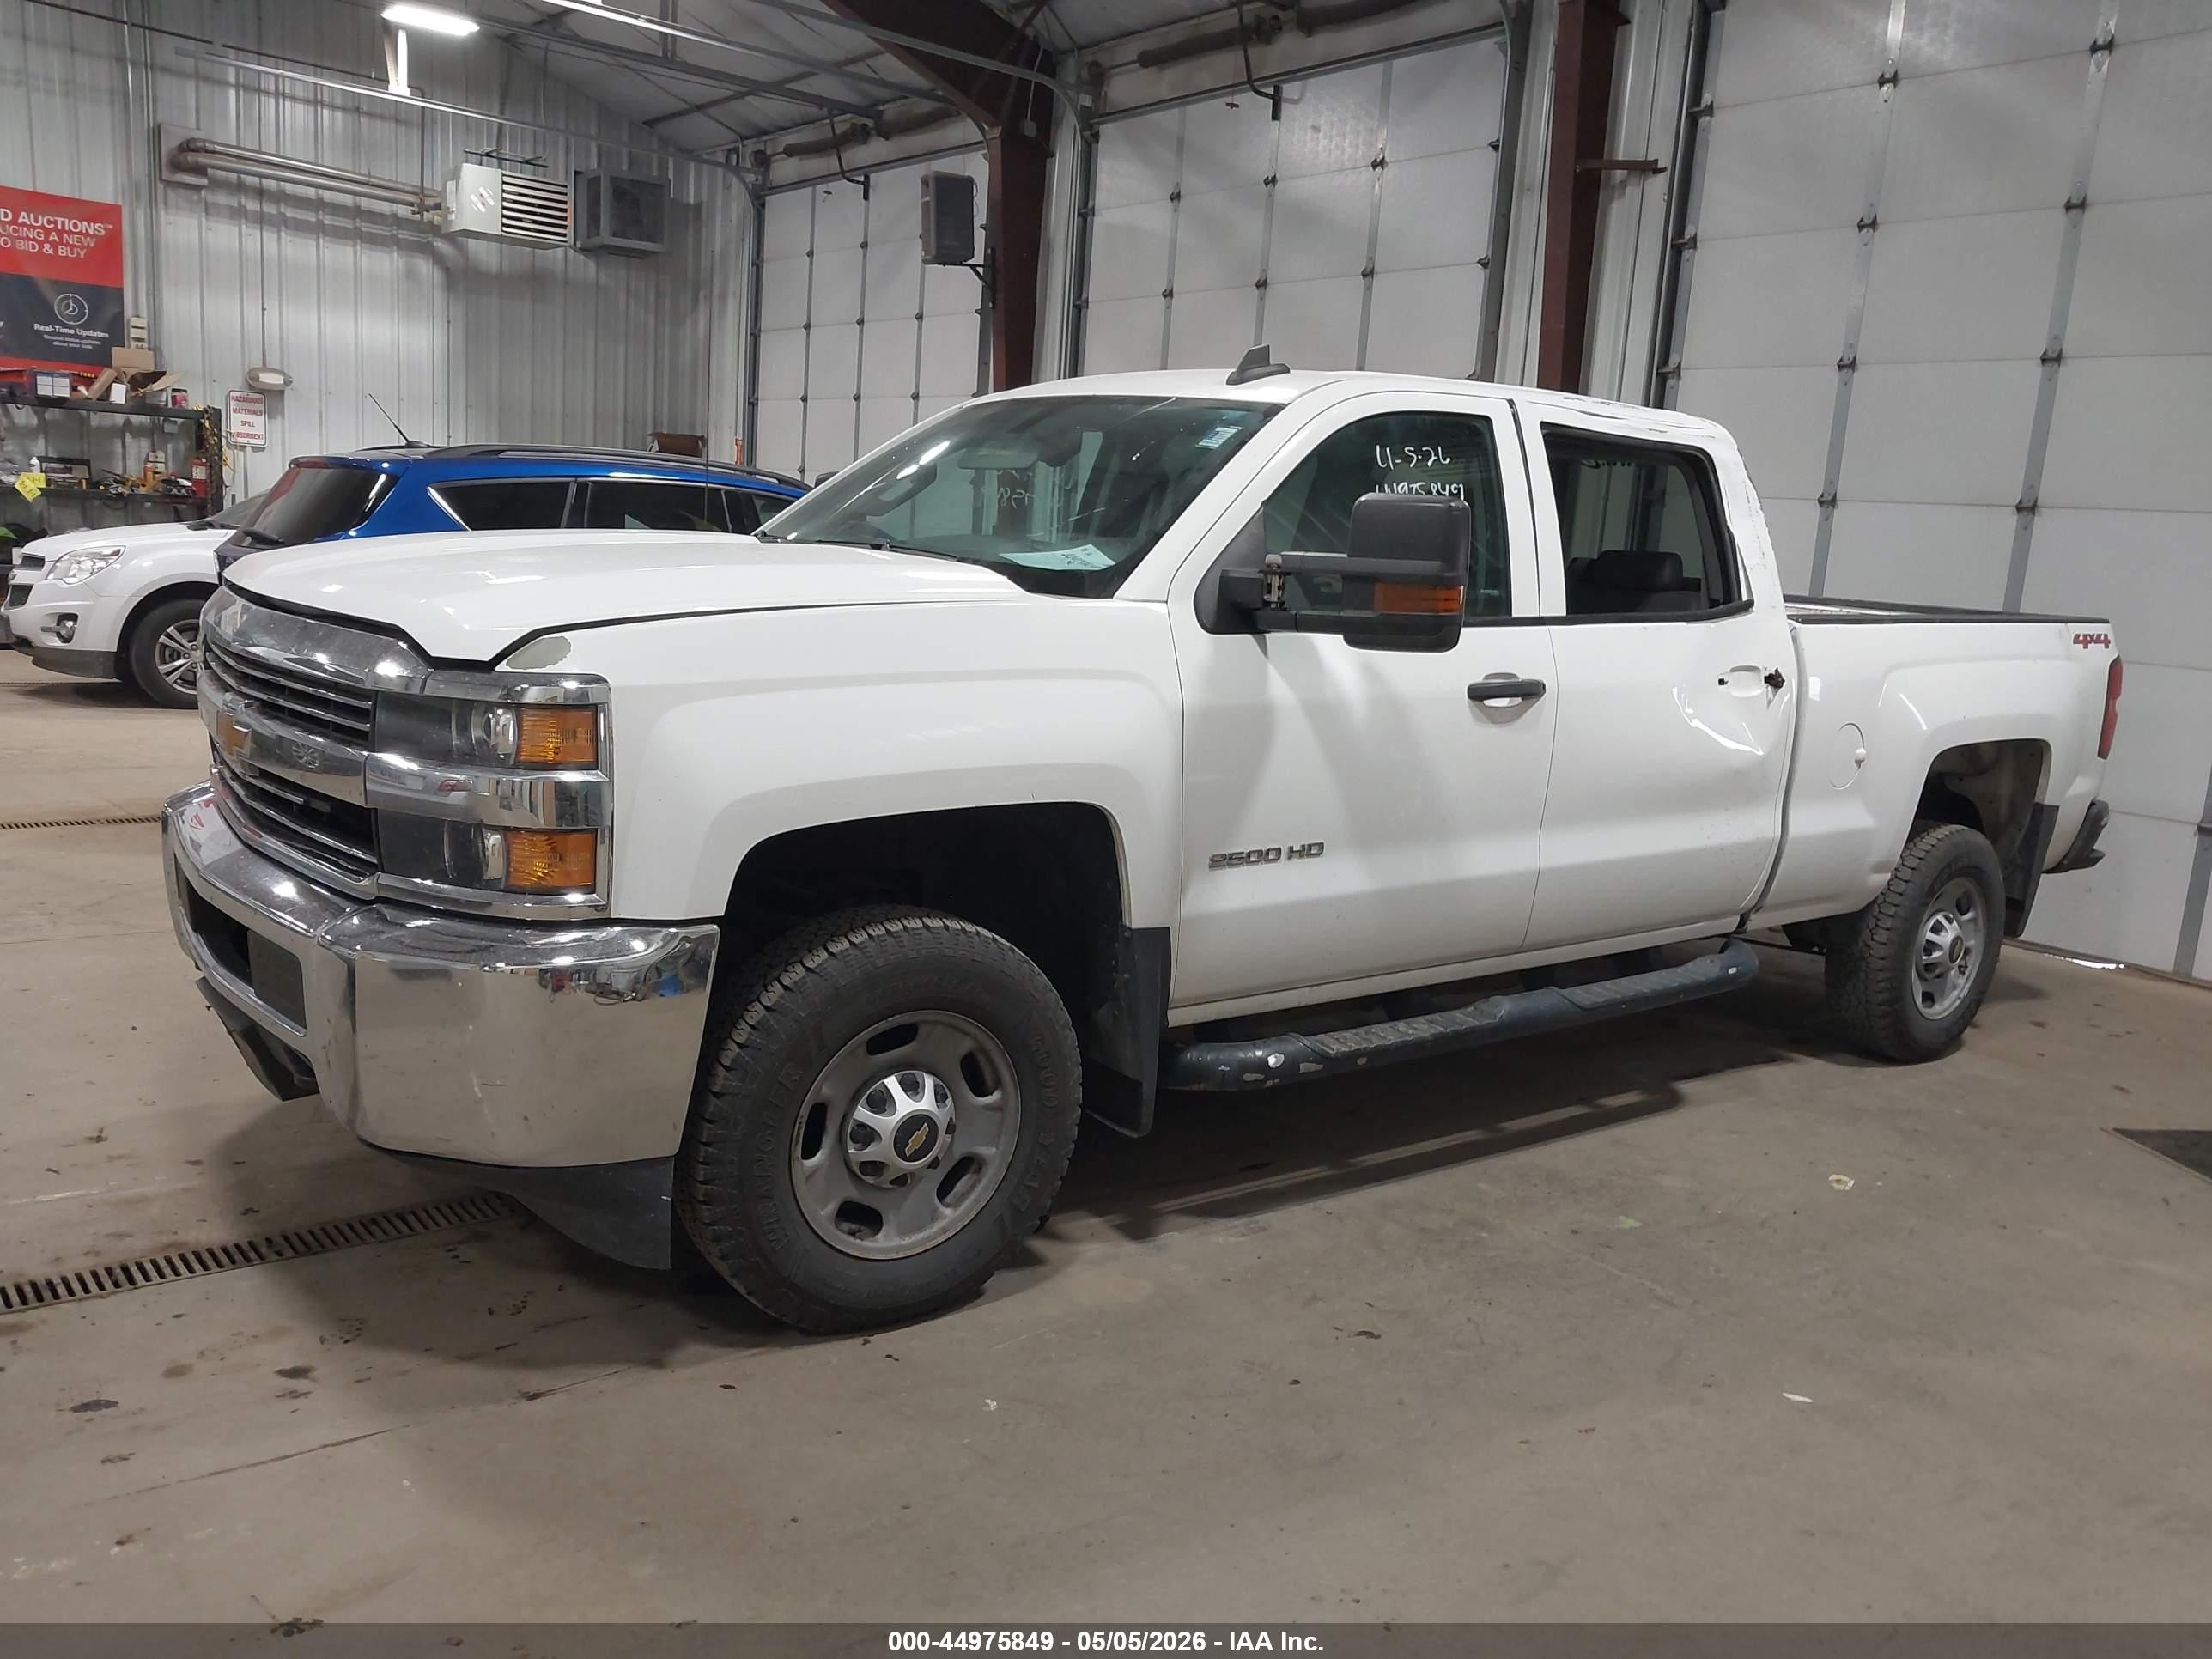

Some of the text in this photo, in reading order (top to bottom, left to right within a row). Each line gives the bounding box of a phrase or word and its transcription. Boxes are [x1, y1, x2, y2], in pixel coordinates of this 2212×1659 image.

[48, 231, 59, 243] A
[63, 233, 96, 247] NEW
[15, 239, 39, 252] BID
[42, 243, 54, 255] &
[58, 245, 87, 259] BUY
[33, 323, 110, 338] Real-Time Updates
[233, 407, 263, 416] MATERIALS
[1208, 842, 1325, 871] 2500 HD
